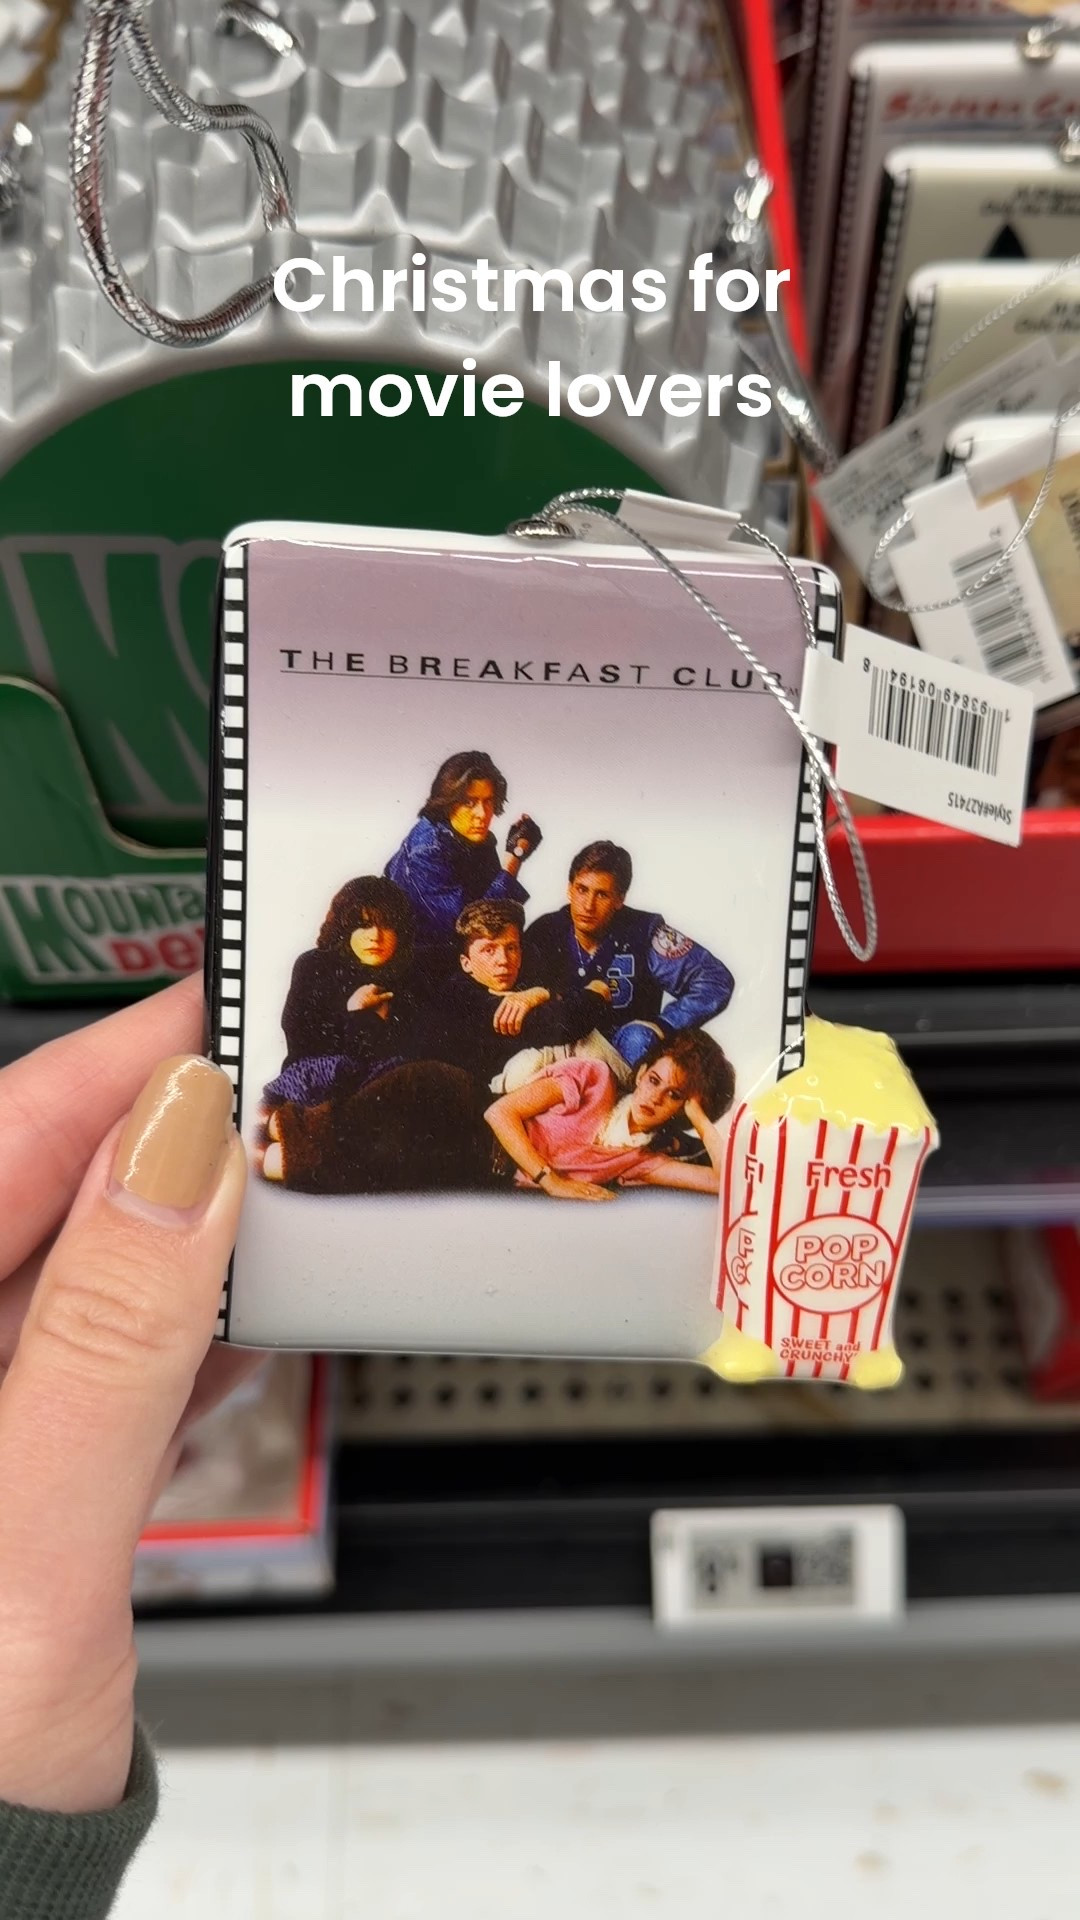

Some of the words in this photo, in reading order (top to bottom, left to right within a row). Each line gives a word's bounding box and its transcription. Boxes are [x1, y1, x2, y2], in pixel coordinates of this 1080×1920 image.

[279, 649, 366, 673] THE
[389, 654, 650, 685] BREAKFAST
[862, 657, 871, 673] 8
[890, 668, 936, 697] 08194
[943, 688, 988, 715] 93849
[1004, 708, 1011, 723] 1
[947, 791, 1013, 825] Style#A27415
[806, 1160, 892, 1189] Fresh
[795, 1233, 879, 1264] POP
[779, 1260, 886, 1291] CORN
[780, 1337, 832, 1350] SWEET
[835, 1341, 861, 1352] and
